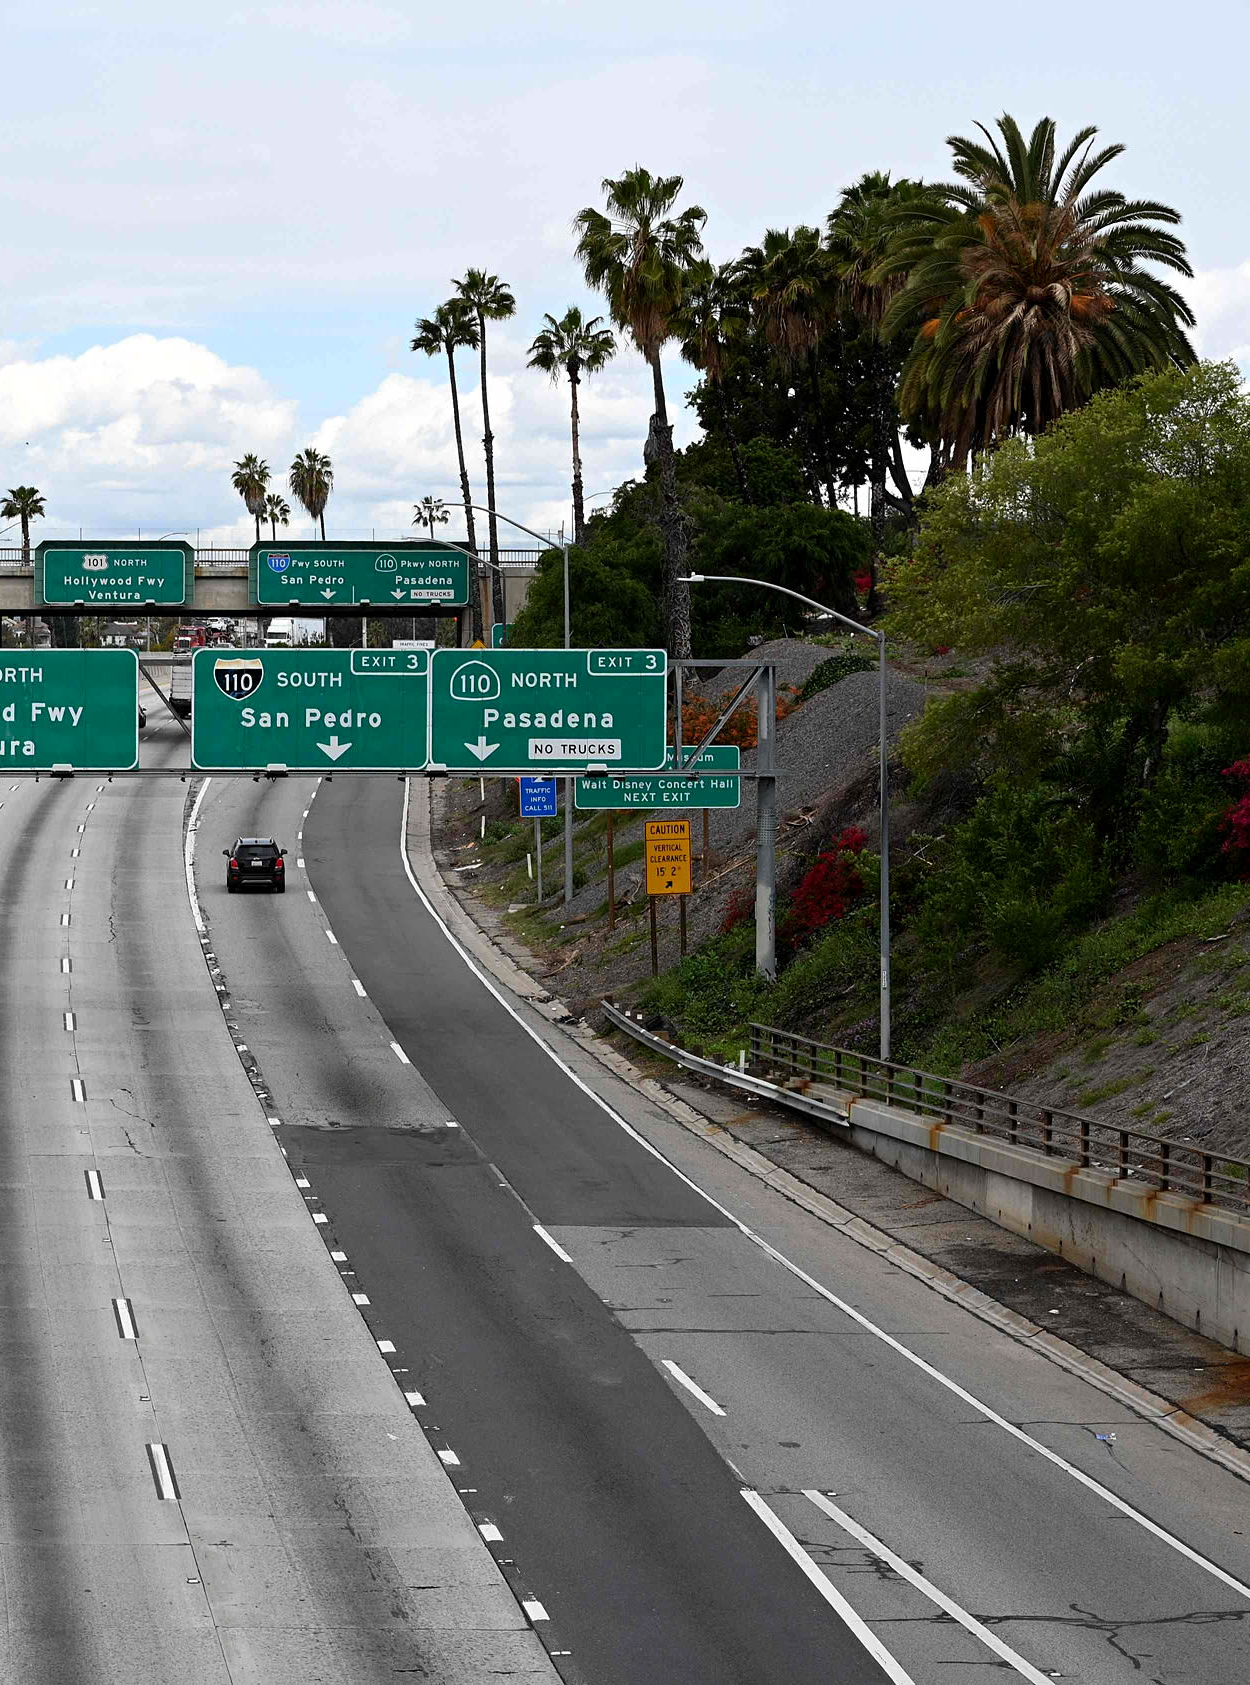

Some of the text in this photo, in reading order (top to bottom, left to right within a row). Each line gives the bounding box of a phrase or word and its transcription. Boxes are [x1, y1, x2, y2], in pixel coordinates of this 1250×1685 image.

[88, 558, 103, 567] 101
[271, 559, 286, 568] 110
[292, 560, 310, 568] Fwy
[379, 559, 394, 568] 110
[64, 576, 164, 587] Hollywood Fwy
[281, 575, 343, 584] San Pedro
[396, 576, 452, 584] Pasadena
[89, 591, 140, 599] Ventura
[362, 655, 418, 669] EXIT 3
[599, 655, 656, 669] EXIT 3
[224, 672, 341, 691] 110 SOUTH
[461, 673, 576, 693] 110 NORTH
[32, 703, 83, 726] Fwy
[241, 708, 381, 727] San Pedro
[484, 709, 613, 728] Pasadena
[535, 744, 614, 754] NO TRUCKS
[582, 780, 732, 790] Walt Disney Concert Hall
[624, 793, 690, 801] NEXT EXIT
[650, 824, 685, 835] CAUTION
[654, 844, 682, 852] VERTICAL
[650, 854, 687, 863] CLEARANCE
